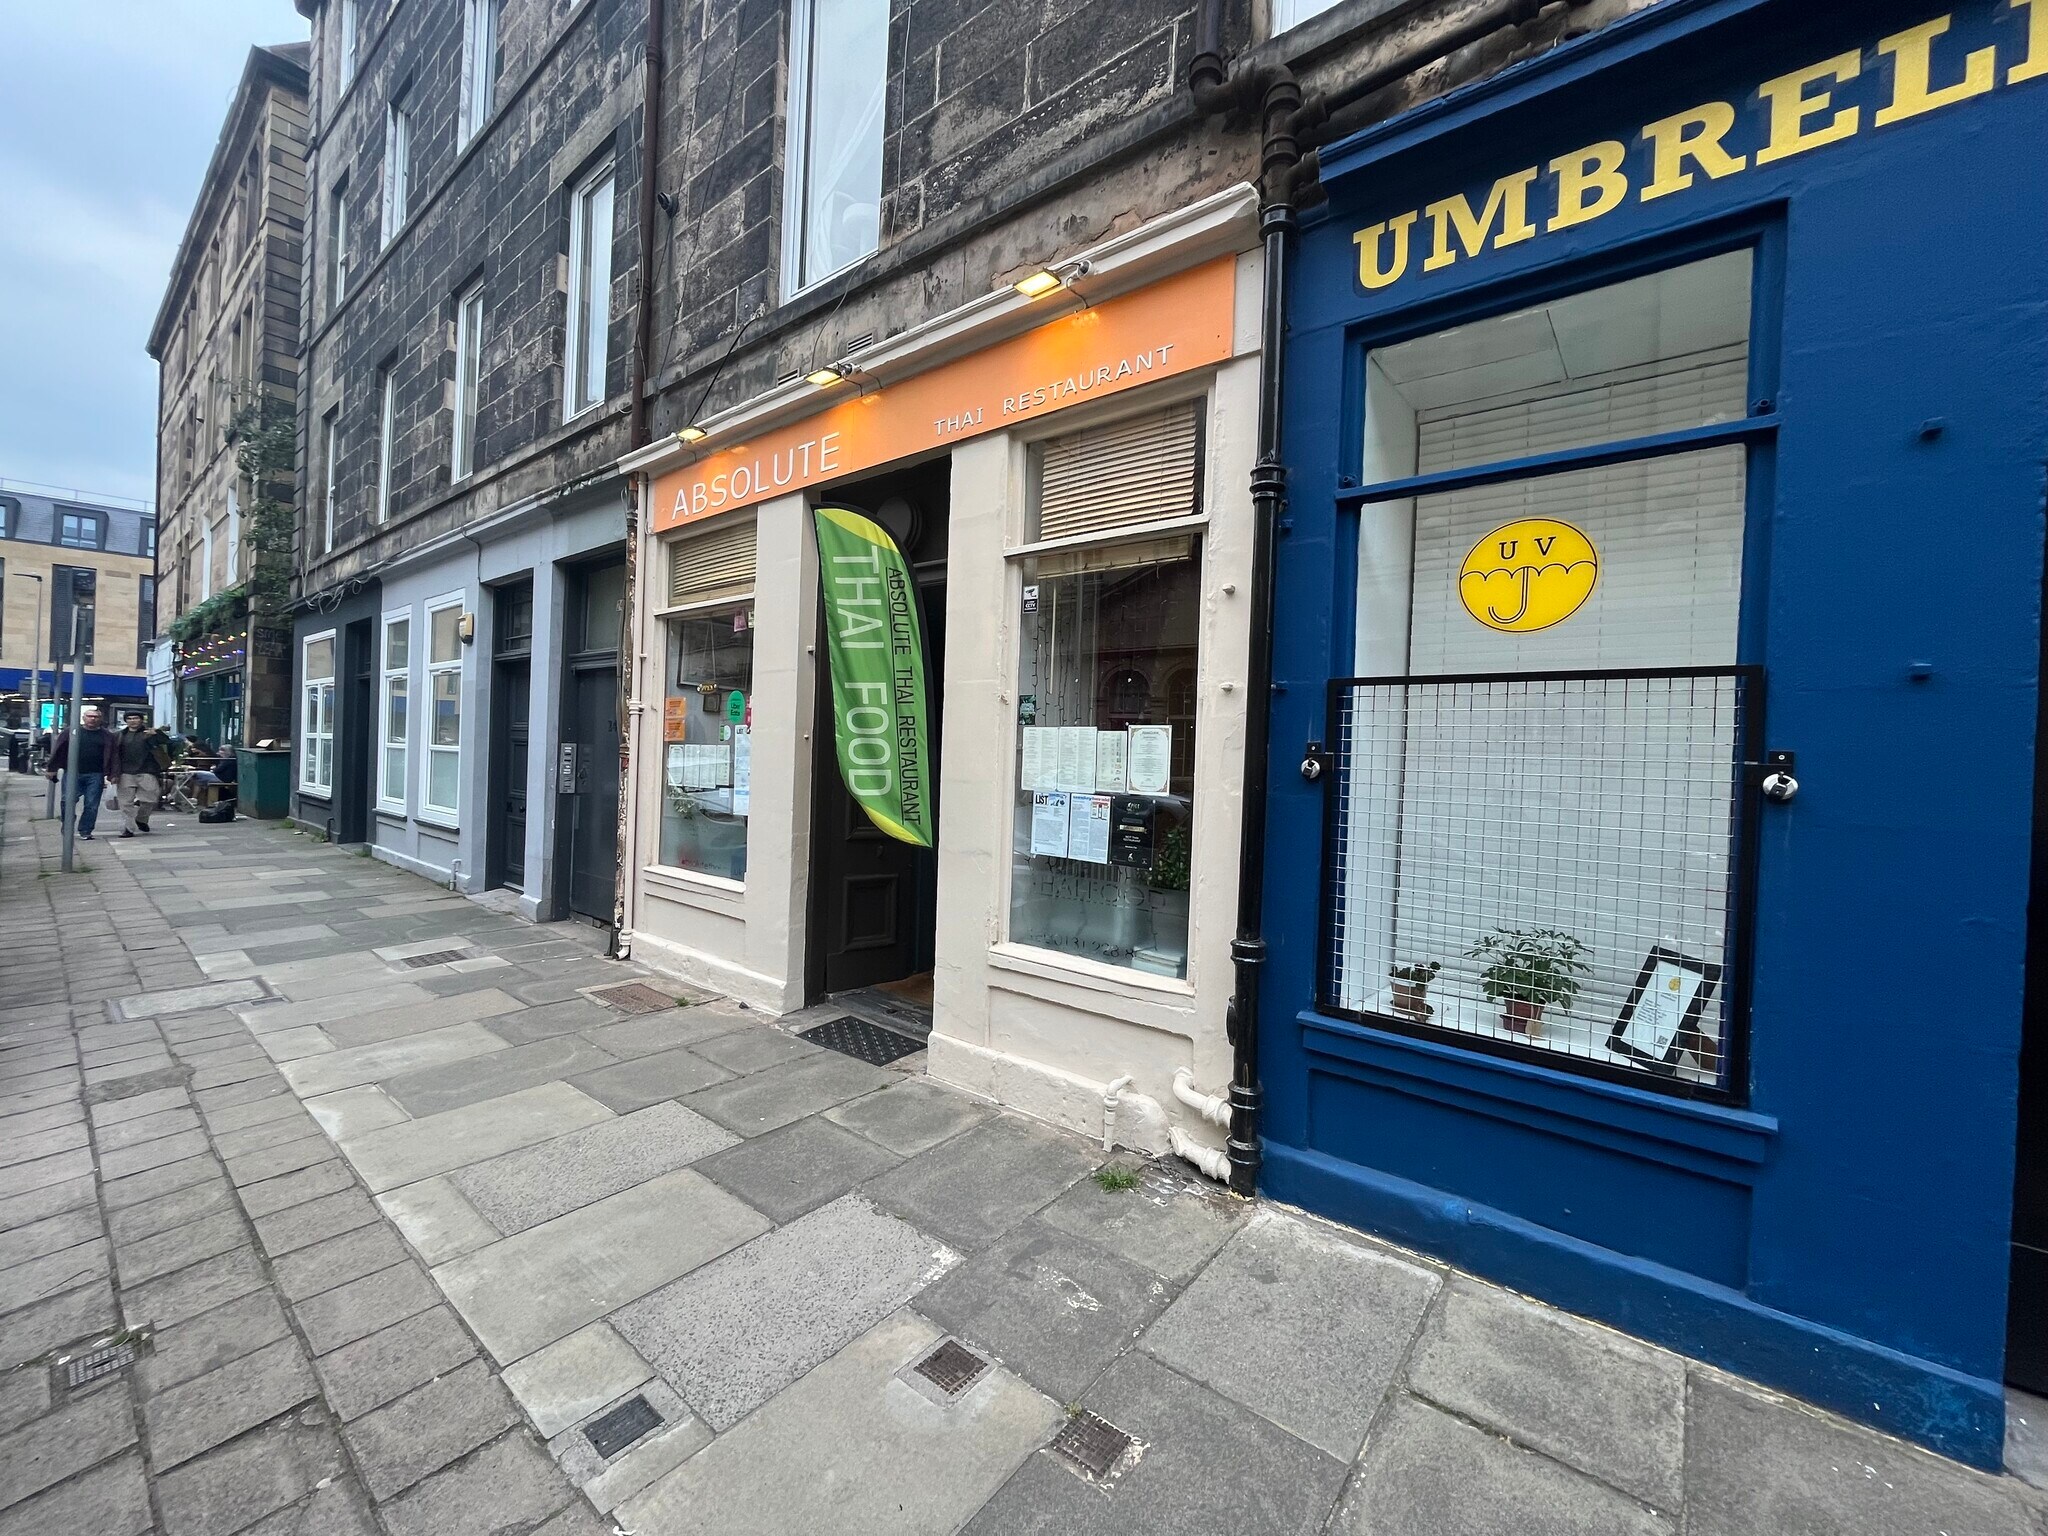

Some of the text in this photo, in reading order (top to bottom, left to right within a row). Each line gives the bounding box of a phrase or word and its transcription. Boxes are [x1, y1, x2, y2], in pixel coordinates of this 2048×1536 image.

[672, 343, 1175, 521] ABSOLUTE THAI RESTAURANT
[833, 545, 892, 797] THAI FOOD
[889, 567, 921, 826] ABSOLUTE THAI RESTAURANT
